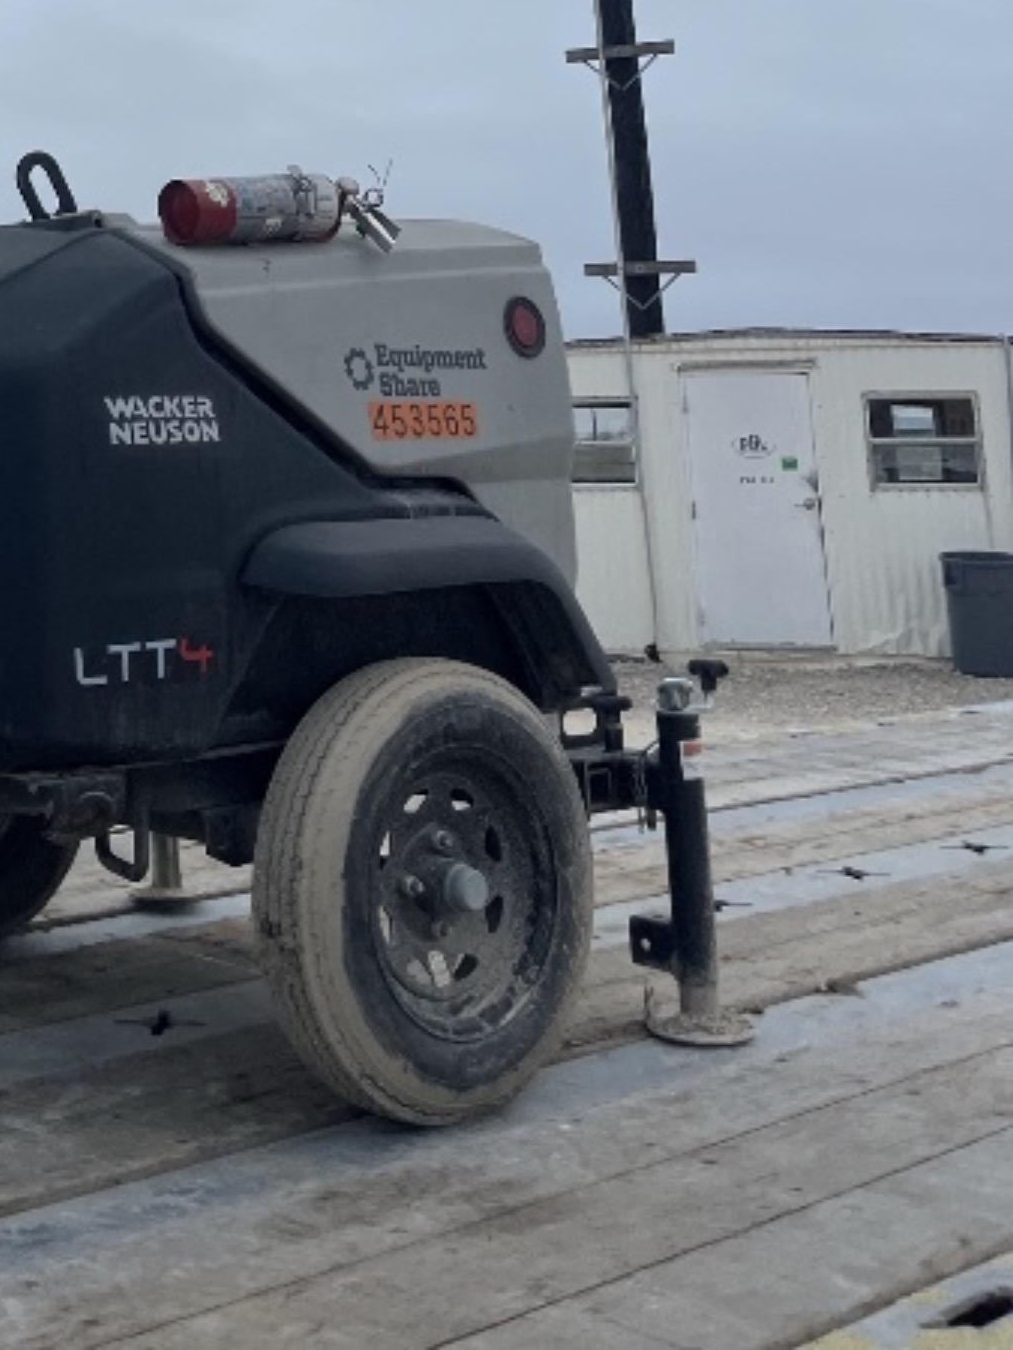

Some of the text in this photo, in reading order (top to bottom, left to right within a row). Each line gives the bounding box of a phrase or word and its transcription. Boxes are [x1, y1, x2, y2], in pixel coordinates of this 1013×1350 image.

[374, 343, 487, 372] Equipment
[379, 372, 441, 397] Share
[103, 395, 216, 419] WACKER
[109, 419, 221, 445] NEUSON
[373, 403, 477, 438] 453565
